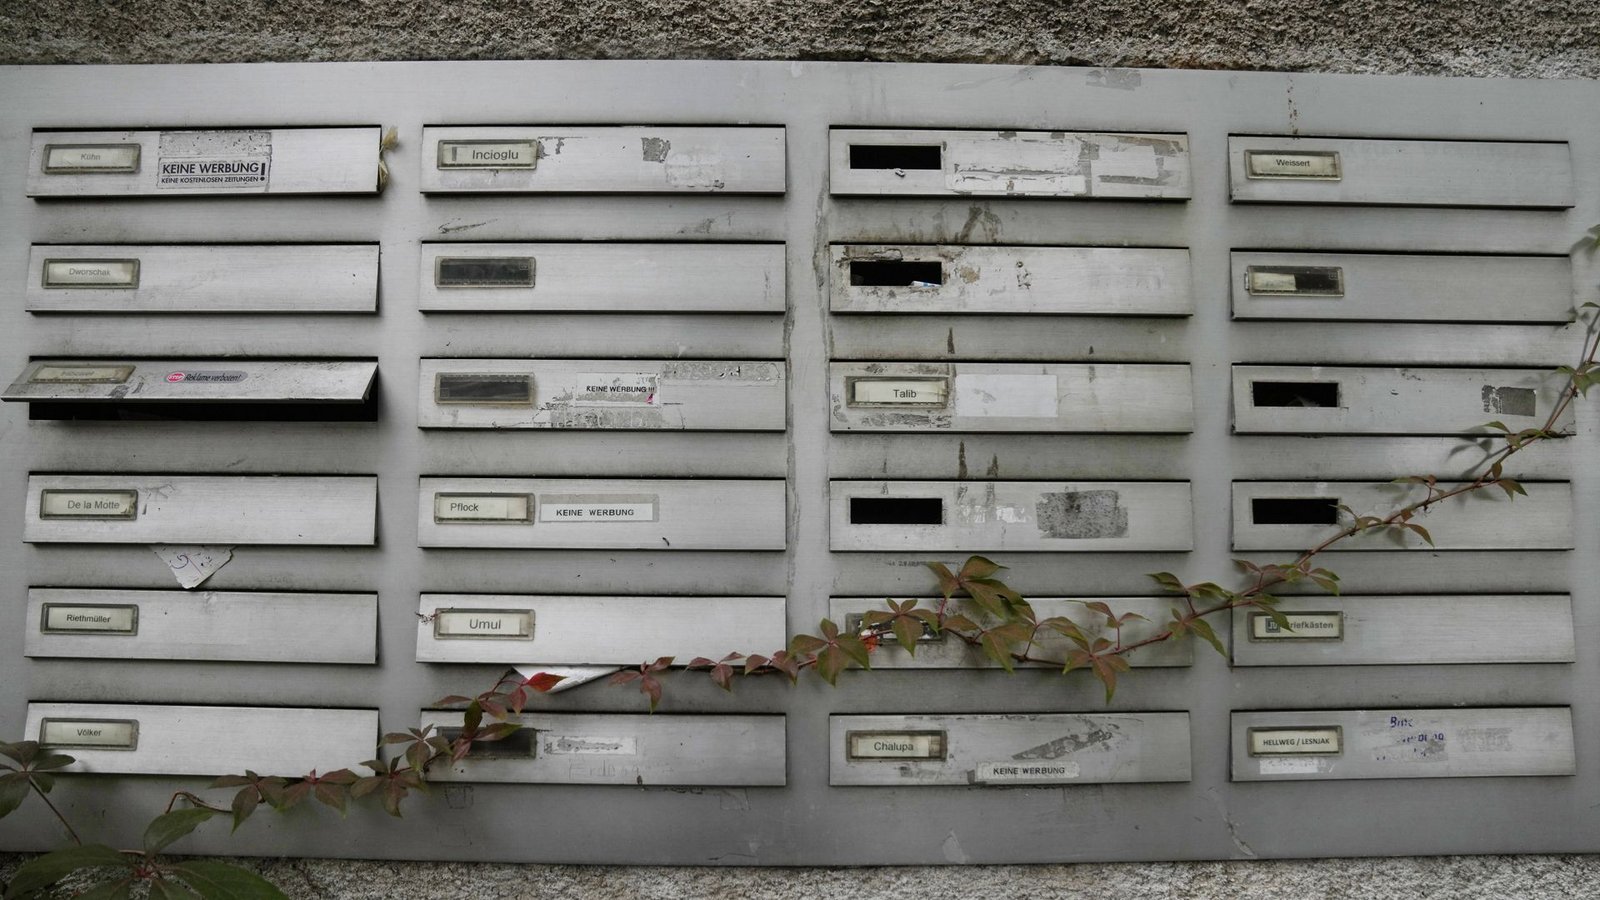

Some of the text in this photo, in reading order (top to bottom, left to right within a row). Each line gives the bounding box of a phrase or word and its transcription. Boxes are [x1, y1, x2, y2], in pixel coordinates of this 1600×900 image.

[472, 144, 519, 160] Incioglu
[1276, 158, 1311, 167] Weissert
[162, 163, 196, 174] KEINE
[69, 267, 111, 276] Dworschak
[185, 372, 211, 381] Reklame
[586, 385, 608, 393] KEINE
[609, 385, 647, 393] WERBUNG
[893, 389, 917, 399] Talib
[67, 500, 120, 510] De la Motte
[450, 502, 479, 512] Pflock
[556, 509, 634, 517] KEINE WERBUNG
[66, 614, 111, 624] Riethmüller
[469, 618, 501, 630] Umul
[1283, 621, 1334, 630] riefkästen
[77, 728, 102, 737] Völker
[873, 741, 914, 753] Chalupa
[993, 766, 1066, 775] KEINE WERBUNG
